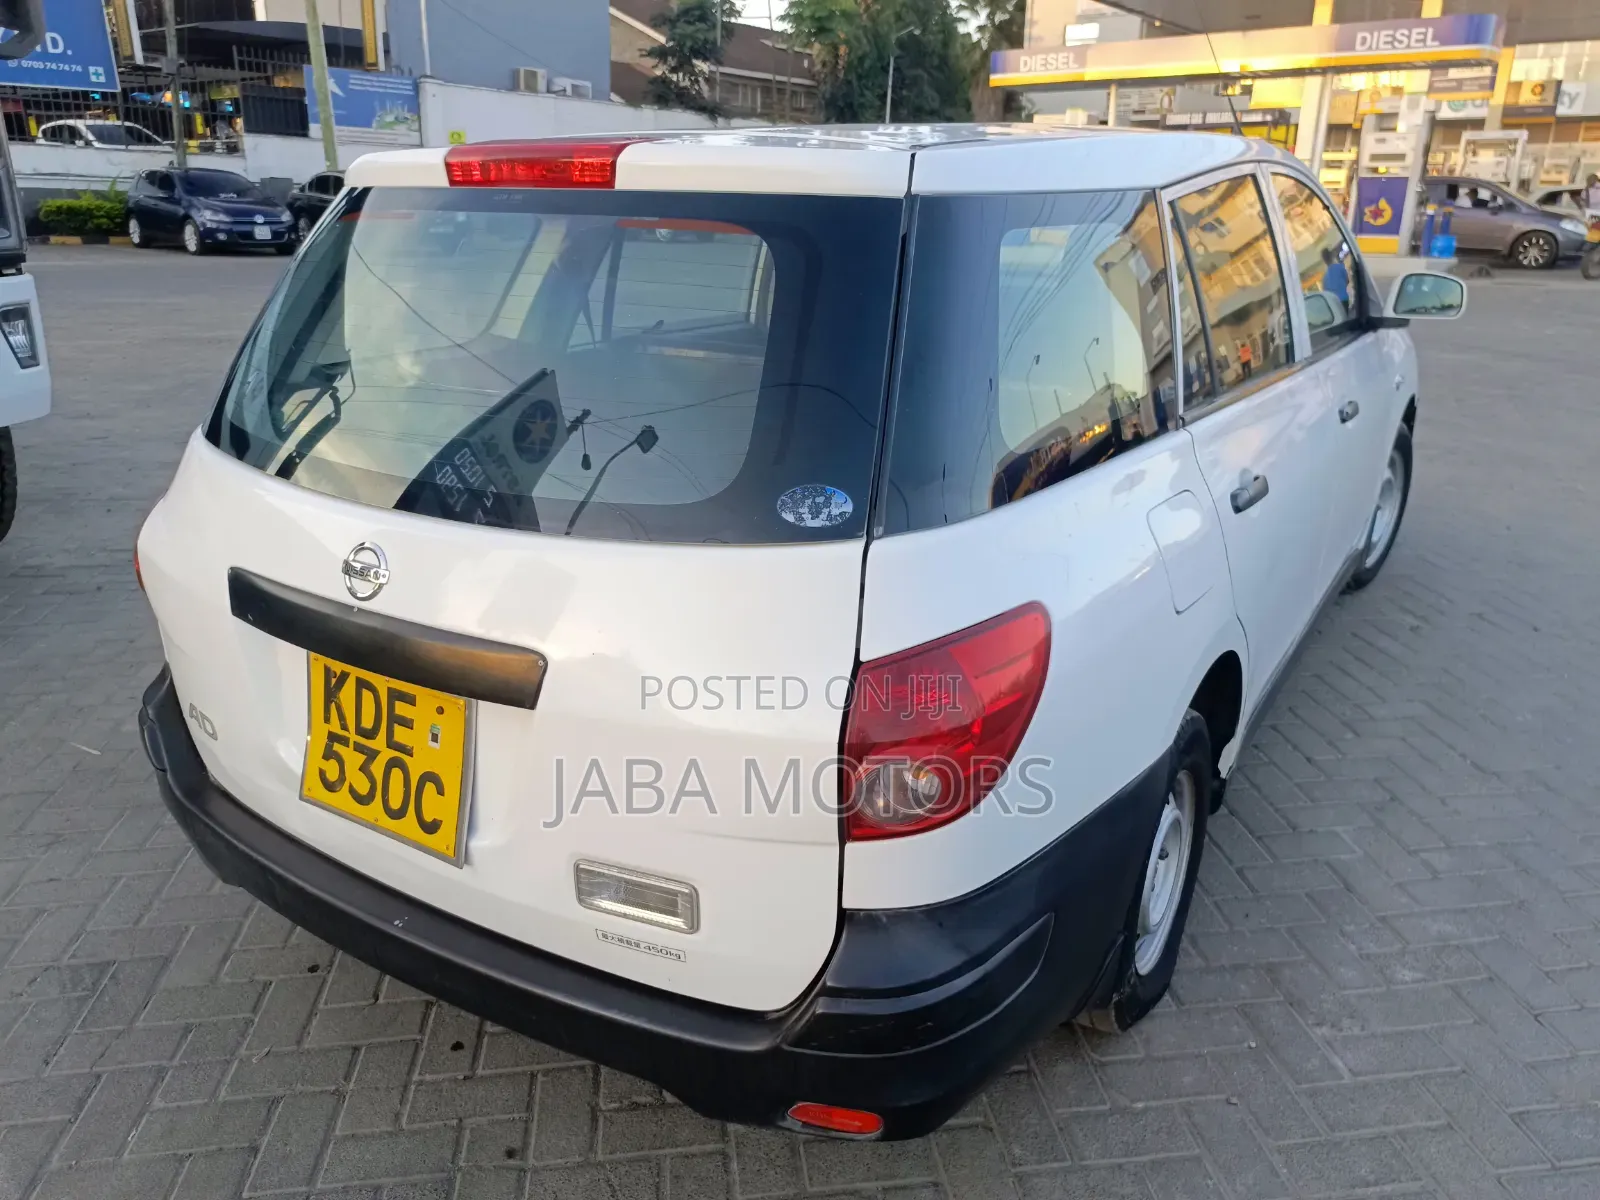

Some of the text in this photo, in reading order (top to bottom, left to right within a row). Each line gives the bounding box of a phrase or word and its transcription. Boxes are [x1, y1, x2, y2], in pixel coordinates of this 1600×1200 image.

[36, 32, 72, 54] D.
[1355, 27, 1440, 52] DIESEL
[1019, 51, 1079, 73] DIESEL
[344, 562, 381, 582] NISSAN
[189, 702, 218, 741] AD
[323, 663, 417, 757] KDE
[318, 730, 446, 836] 530C
[643, 944, 682, 960] 450kg
